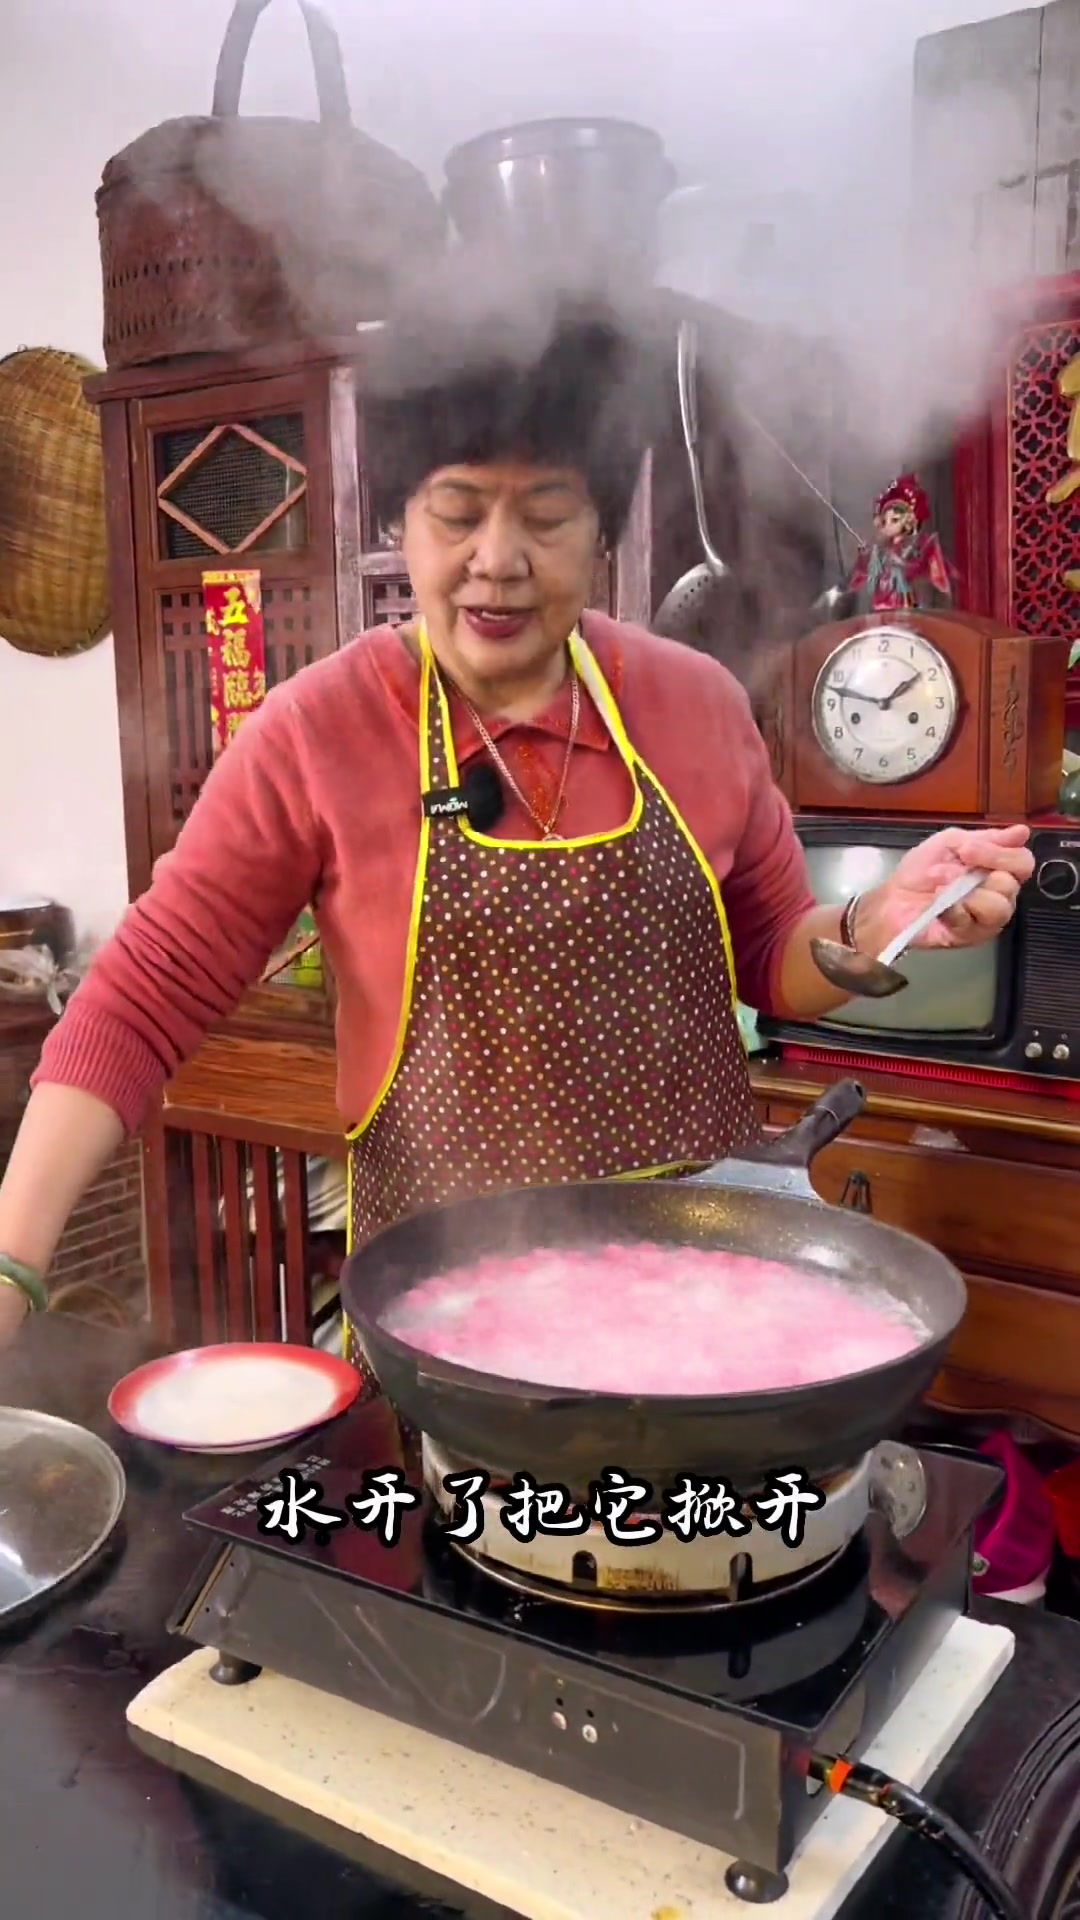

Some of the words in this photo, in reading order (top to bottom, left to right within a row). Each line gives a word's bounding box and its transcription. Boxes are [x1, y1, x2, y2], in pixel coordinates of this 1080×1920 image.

[833, 670, 844, 682] 10
[927, 668, 938, 681] 2
[827, 698, 836, 711] 9
[935, 697, 945, 709] 3
[834, 727, 844, 739] 8
[925, 726, 936, 738] 4
[855, 748, 864, 760] 7
[907, 748, 916, 760] 5
[879, 757, 889, 768] 6
